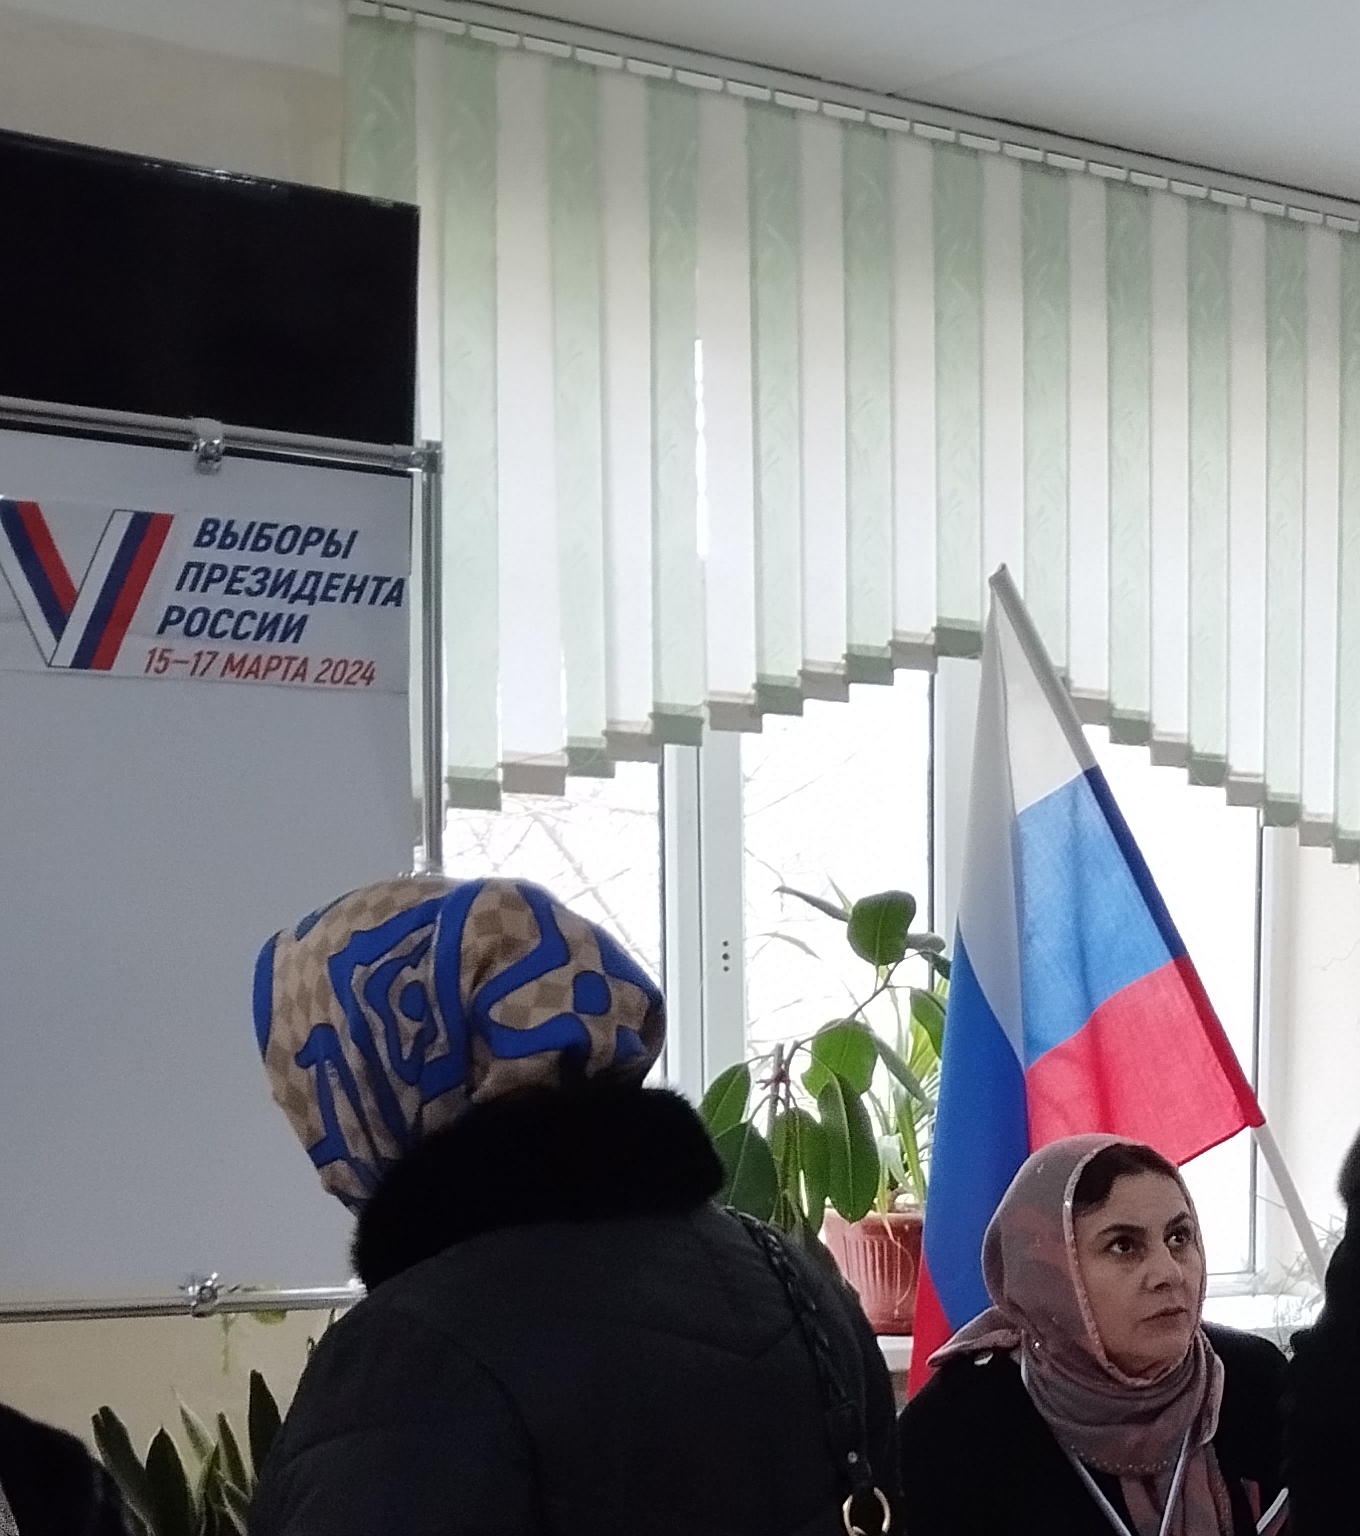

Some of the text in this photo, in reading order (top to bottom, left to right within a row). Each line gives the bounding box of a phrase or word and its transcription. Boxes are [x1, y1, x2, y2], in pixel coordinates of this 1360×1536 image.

[194, 517, 358, 559] ВЫБОРЫ
[175, 561, 407, 607] ПРЕЗИДЕНТА
[157, 605, 309, 643] РОССИИ
[221, 653, 309, 682] МАРТА
[314, 660, 376, 687] 2024
